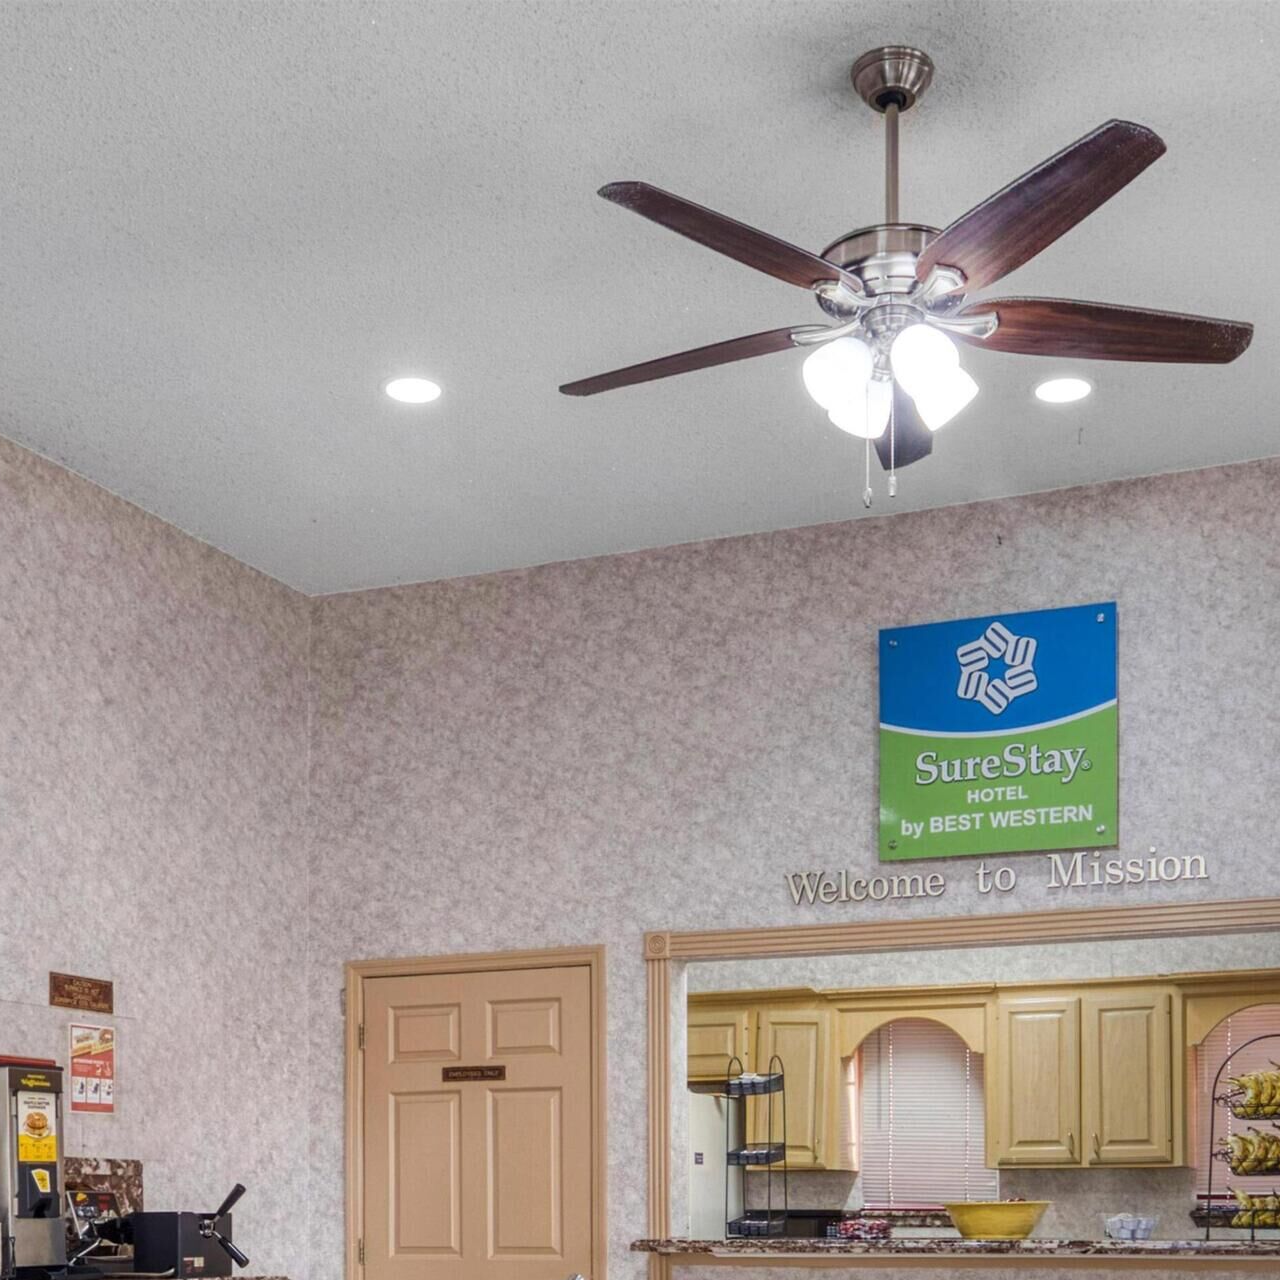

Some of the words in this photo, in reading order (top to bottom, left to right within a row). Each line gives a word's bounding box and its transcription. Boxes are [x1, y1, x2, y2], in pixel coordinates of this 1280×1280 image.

[966, 786, 1029, 804] HOTEL
[900, 818, 923, 839] by
[929, 813, 983, 836] BEST
[988, 804, 1094, 829] WESTERN
[783, 868, 947, 906] Welcome
[976, 860, 1017, 894] to
[1046, 846, 1209, 890] Mission
